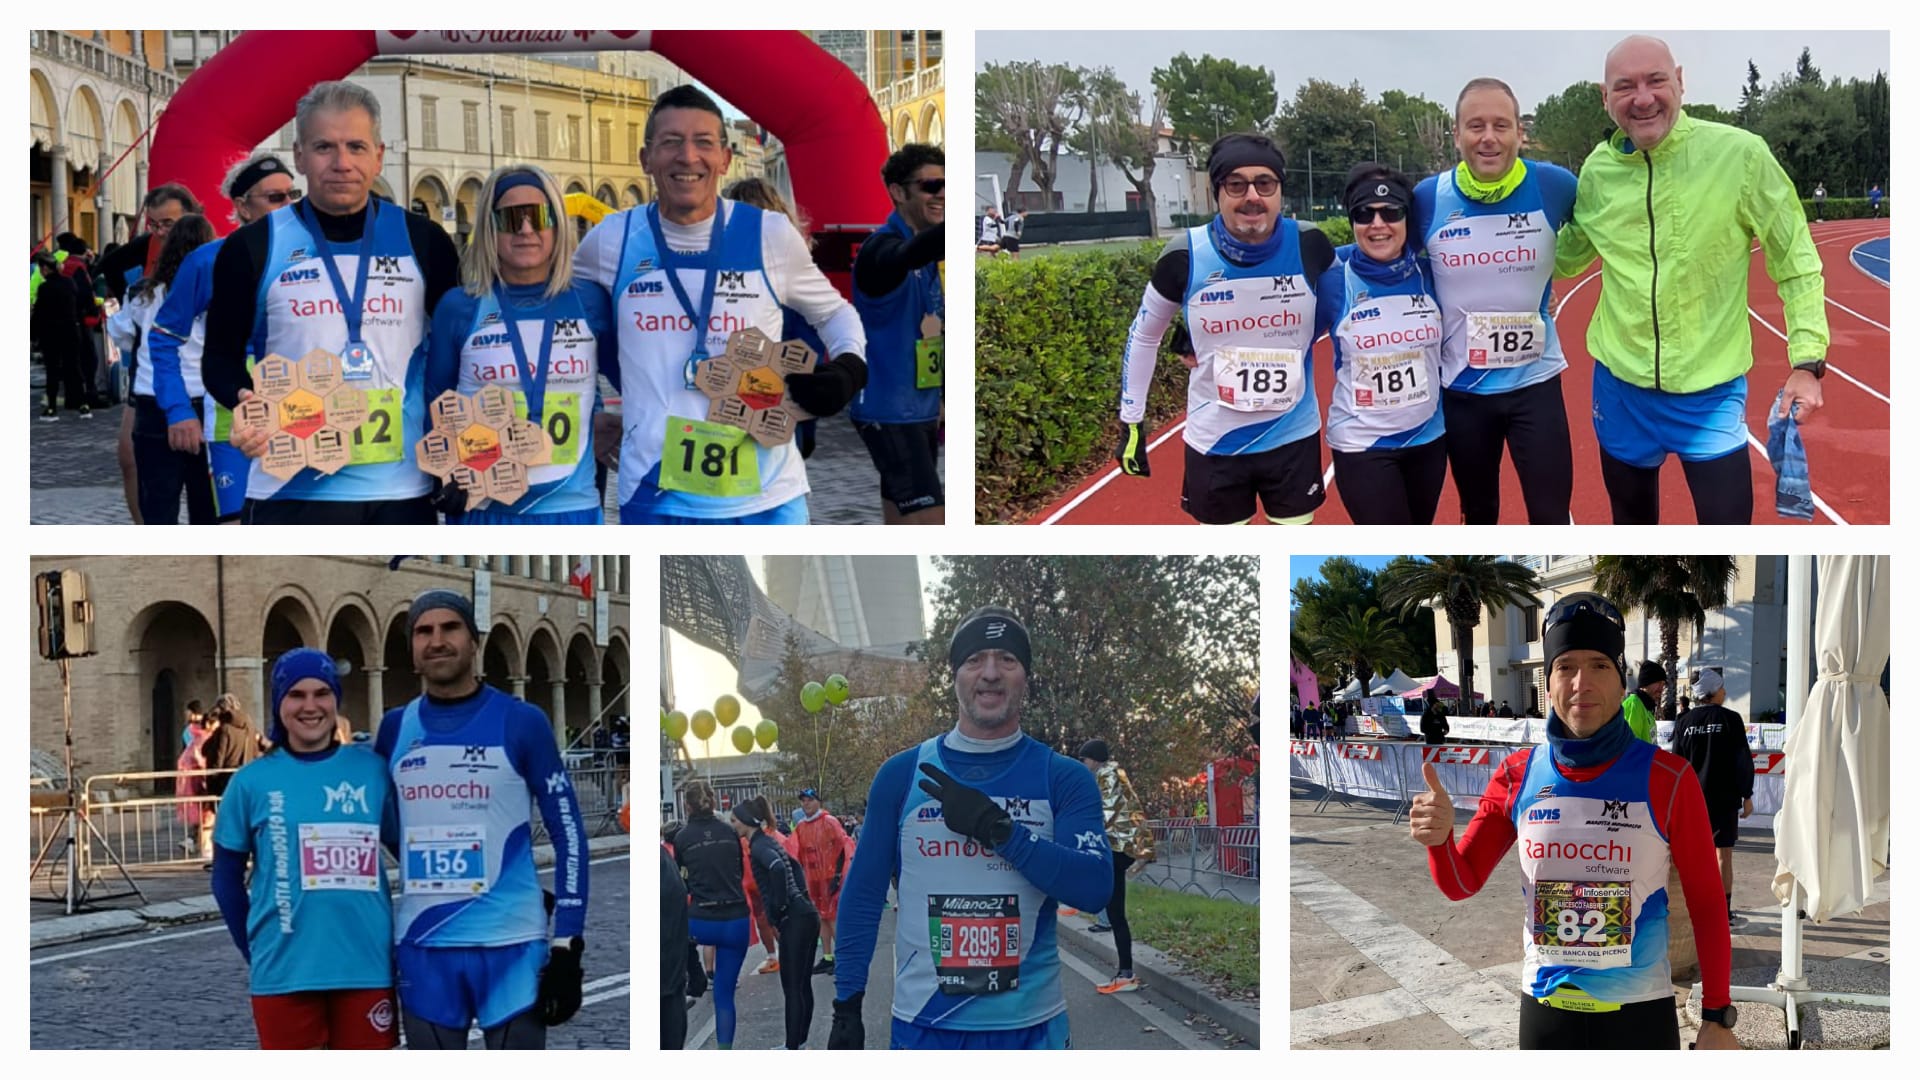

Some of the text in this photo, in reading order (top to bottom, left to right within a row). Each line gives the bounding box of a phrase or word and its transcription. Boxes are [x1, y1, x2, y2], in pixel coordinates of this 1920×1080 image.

[1439, 227, 1472, 240] AVIS
[1440, 245, 1536, 268] Ranocchi
[1498, 264, 1536, 274] software
[628, 281, 664, 294] AVIS
[1200, 290, 1235, 303] AVIS
[288, 293, 403, 317] Ranchi
[634, 311, 745, 332] Ranochi
[1200, 309, 1302, 335] Ranocchi
[1353, 323, 1440, 350] Ranocchi
[1488, 331, 1534, 353] 182
[1236, 368, 1288, 394] 183
[1371, 366, 1416, 394] 181
[680, 438, 739, 477] 181
[1684, 723, 1723, 736] ATHLETE
[918, 807, 944, 819] AV
[1528, 809, 1561, 821] AVIS
[313, 847, 372, 872] 5087
[1525, 840, 1632, 863] Ranocchi
[421, 849, 468, 877] 156
[1585, 863, 1630, 875] software
[1583, 887, 1630, 897] Infoservice
[942, 898, 1004, 910] Milano21
[1557, 909, 1606, 943] 82
[959, 926, 1000, 957] 2895
[1602, 948, 1628, 957] PICENO
